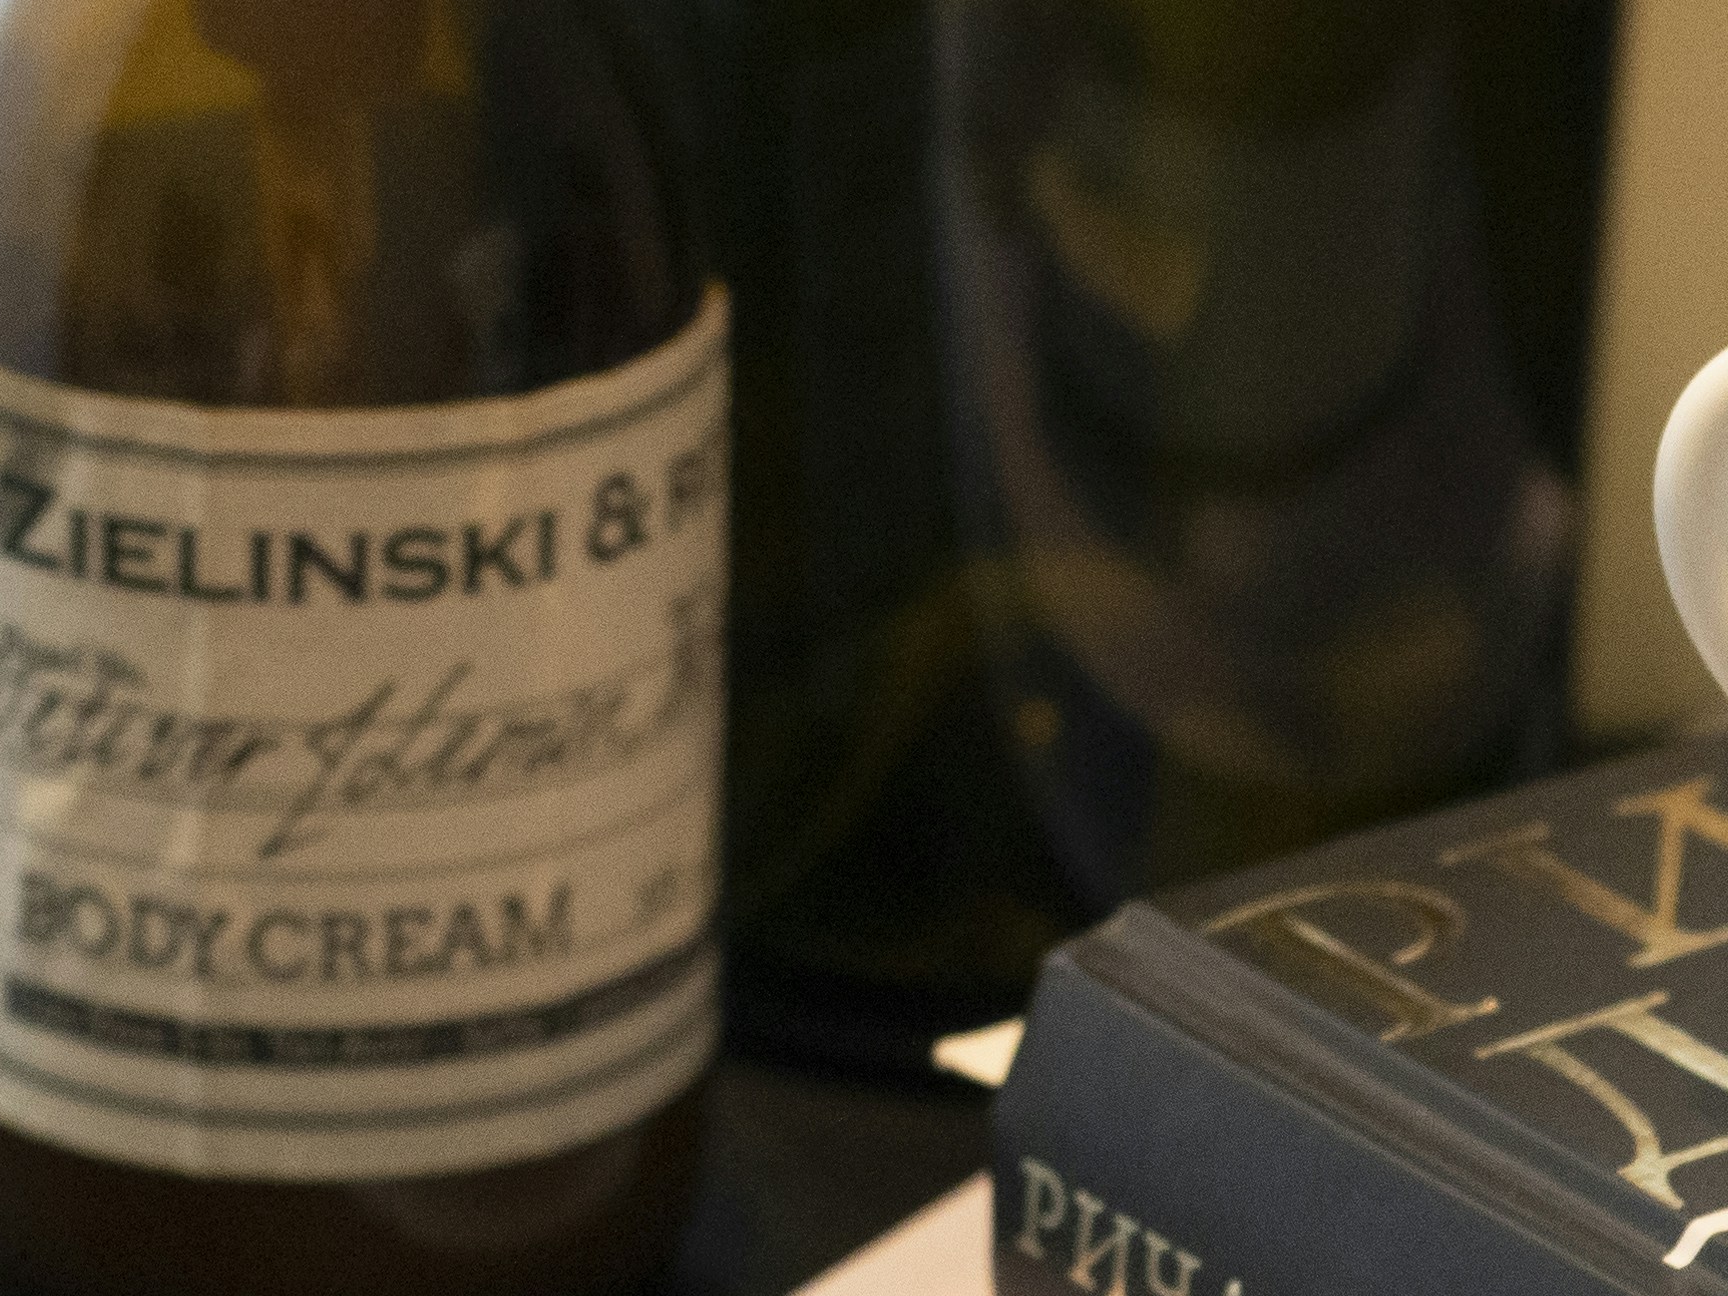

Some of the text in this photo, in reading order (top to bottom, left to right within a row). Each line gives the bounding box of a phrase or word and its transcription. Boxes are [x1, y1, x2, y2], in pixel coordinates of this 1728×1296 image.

[585, 470, 650, 563] &
[16, 872, 234, 983] BODY
[246, 882, 577, 985] CREAM
